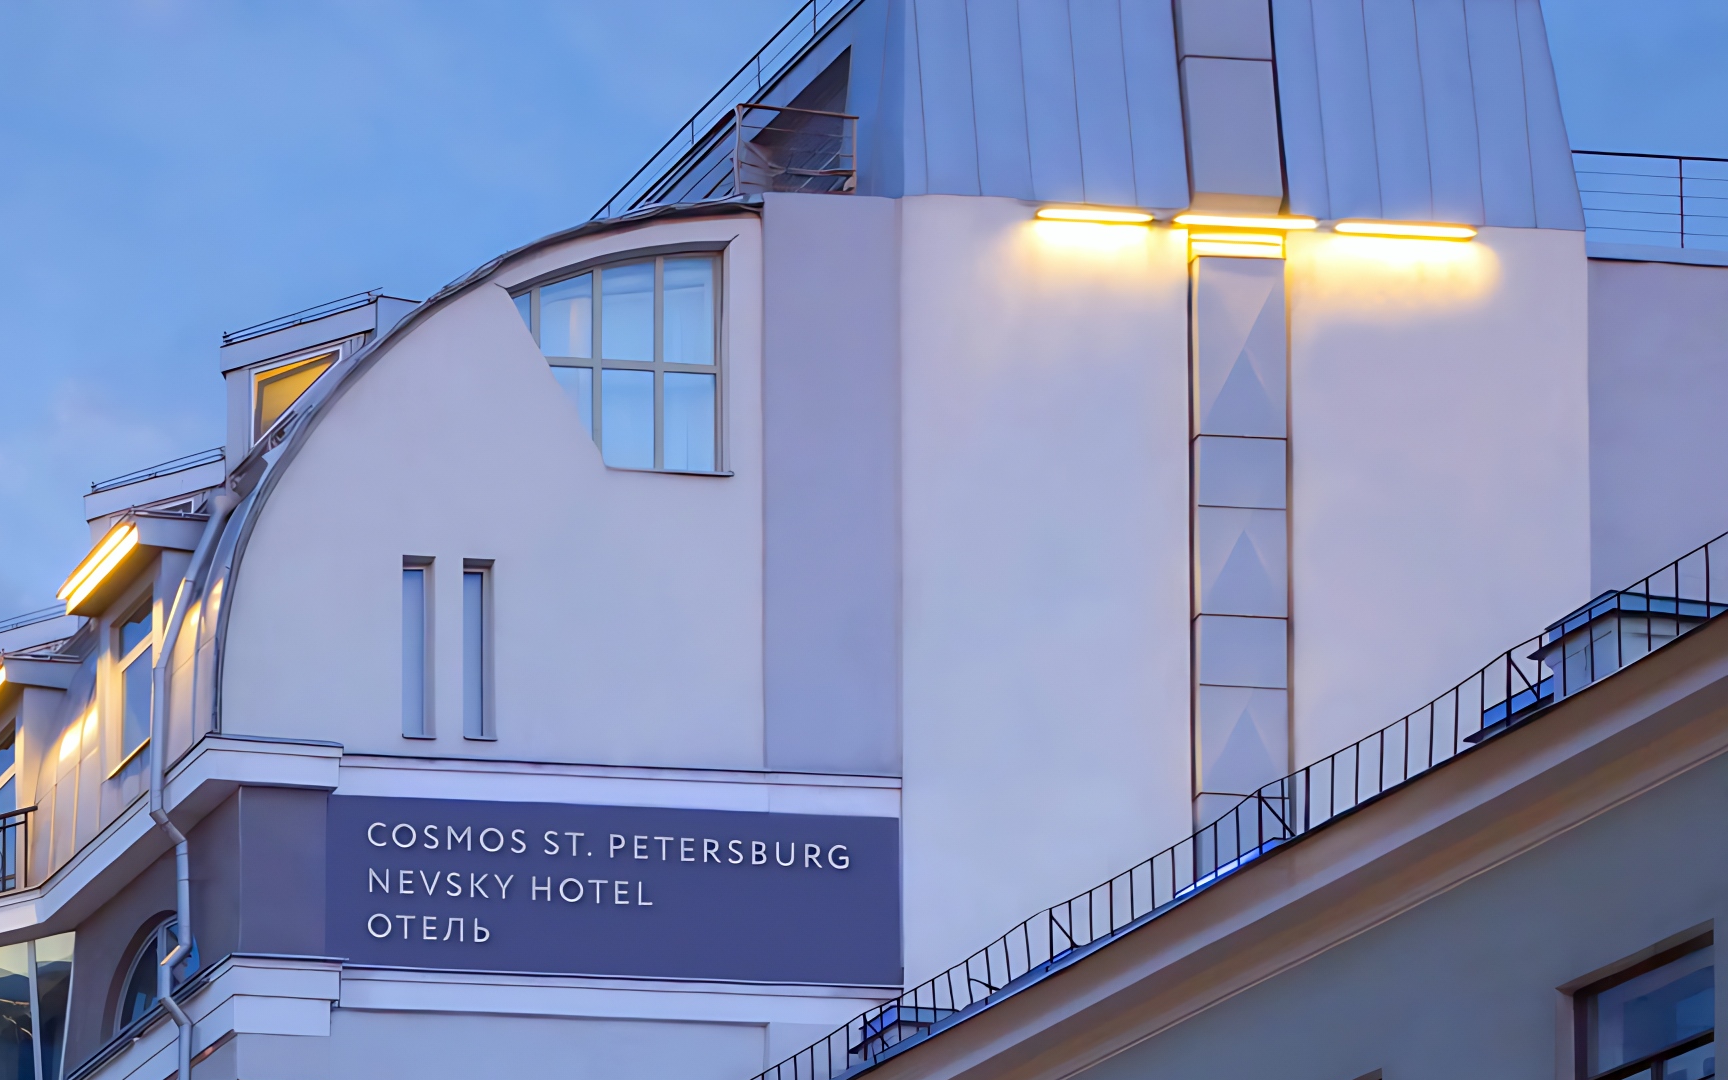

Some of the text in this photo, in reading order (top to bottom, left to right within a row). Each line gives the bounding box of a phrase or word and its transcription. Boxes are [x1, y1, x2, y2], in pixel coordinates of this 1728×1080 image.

[367, 821, 851, 870] COSMOS ST. PETERSBURG
[368, 867, 654, 906] NEVSKY HOTEL
[367, 912, 491, 943] ОТЕЛЬ
